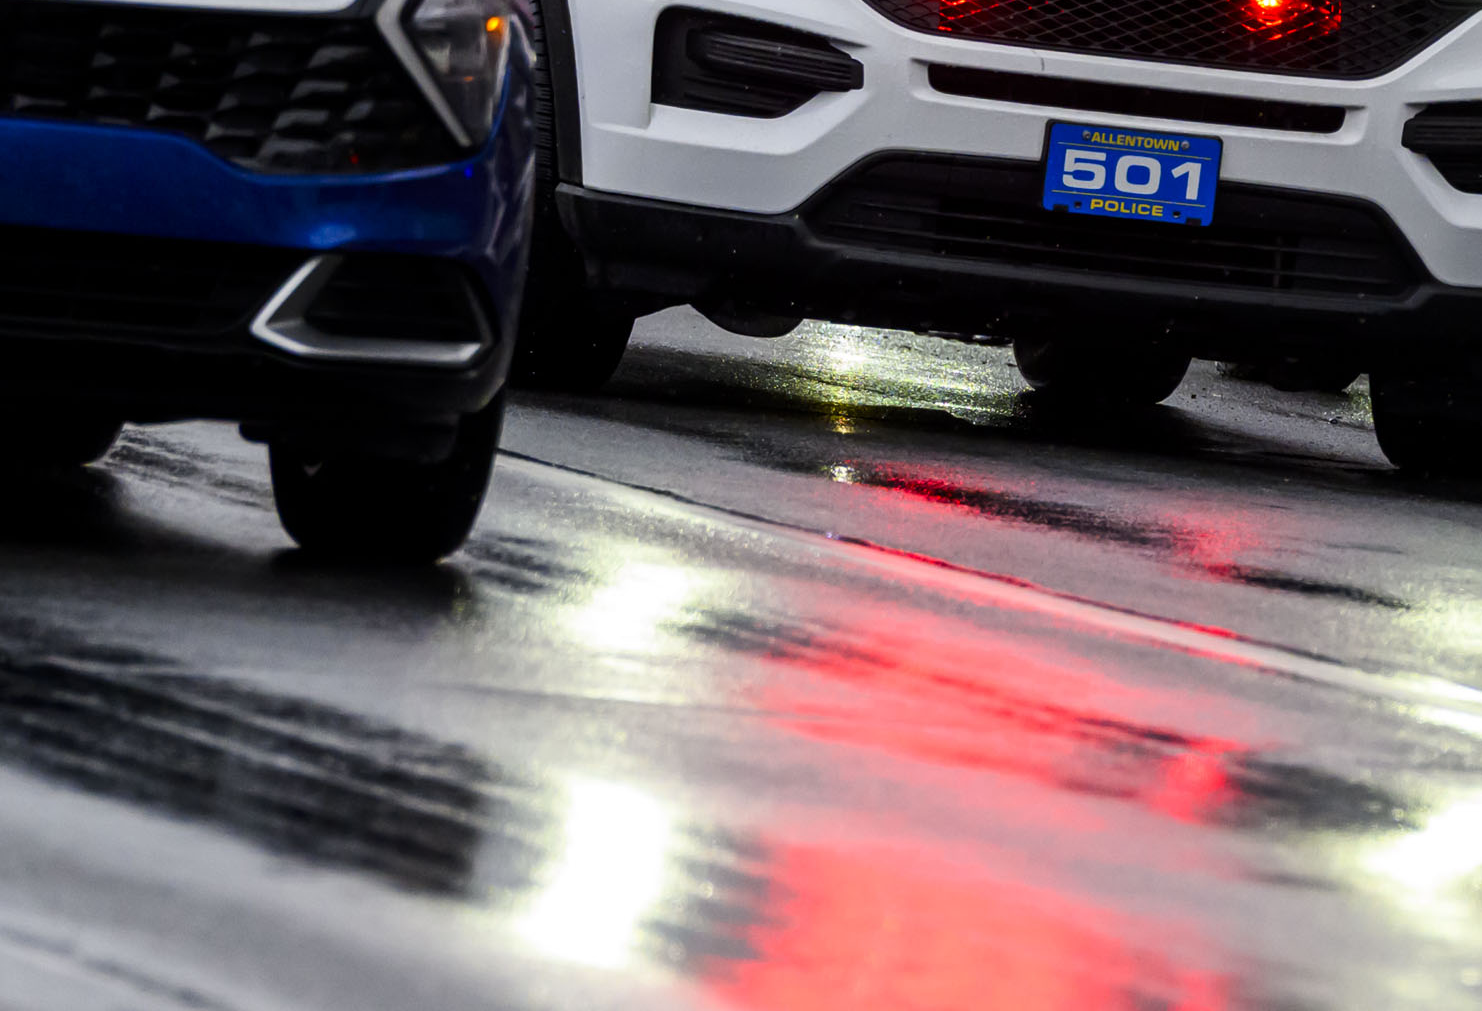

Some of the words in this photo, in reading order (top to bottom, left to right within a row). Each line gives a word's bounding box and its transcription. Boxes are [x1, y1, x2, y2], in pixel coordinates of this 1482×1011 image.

[1091, 131, 1180, 152] ALLENTOWN
[1062, 149, 1202, 200] 501
[1090, 198, 1163, 217] POLICE
